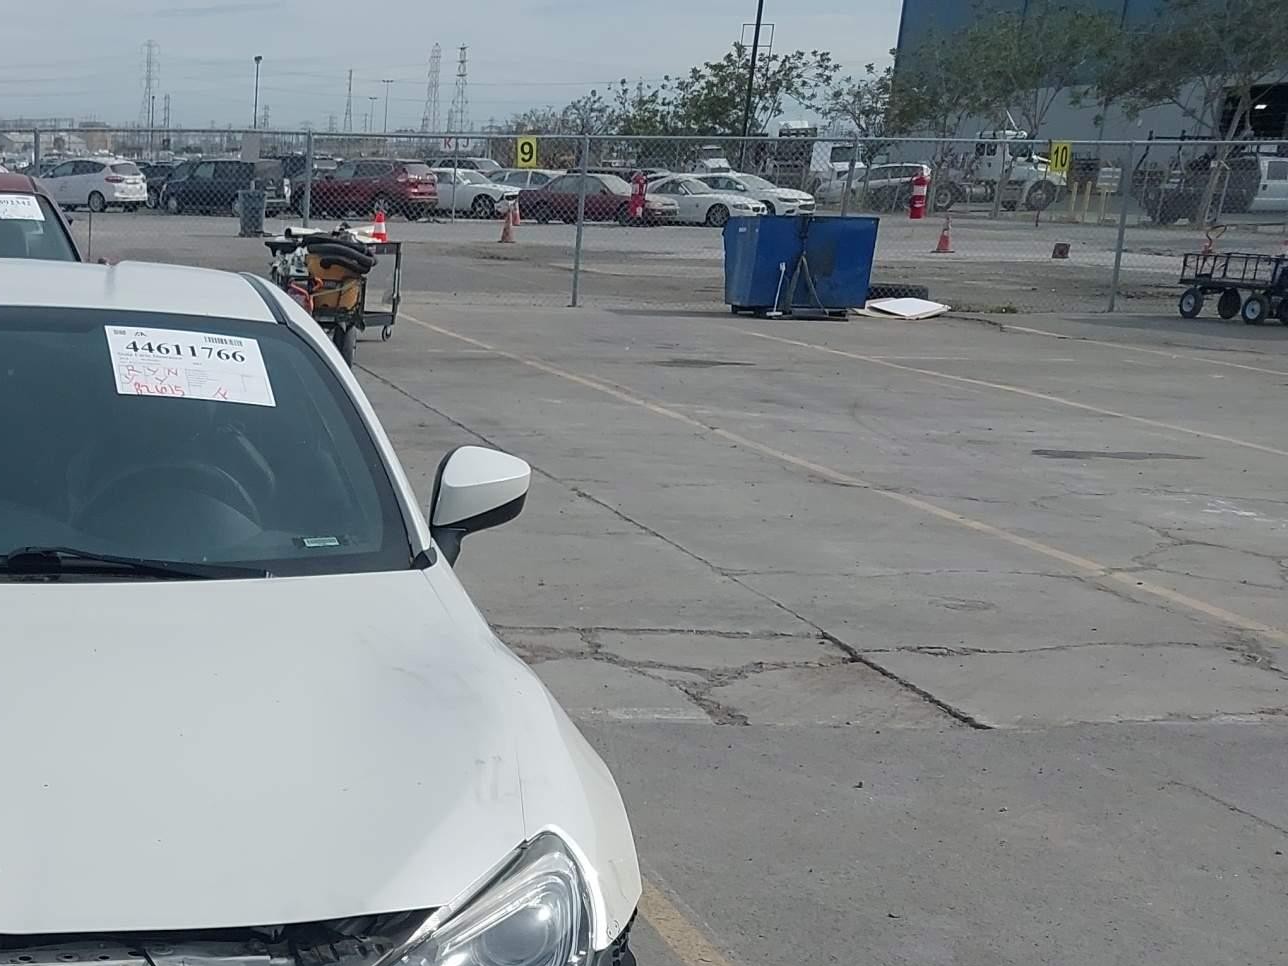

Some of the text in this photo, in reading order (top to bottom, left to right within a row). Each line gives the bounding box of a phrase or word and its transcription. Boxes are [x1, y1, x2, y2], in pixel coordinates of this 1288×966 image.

[520, 141, 534, 162] 9
[1053, 145, 1068, 168] 10
[125, 340, 246, 363] 44611766
